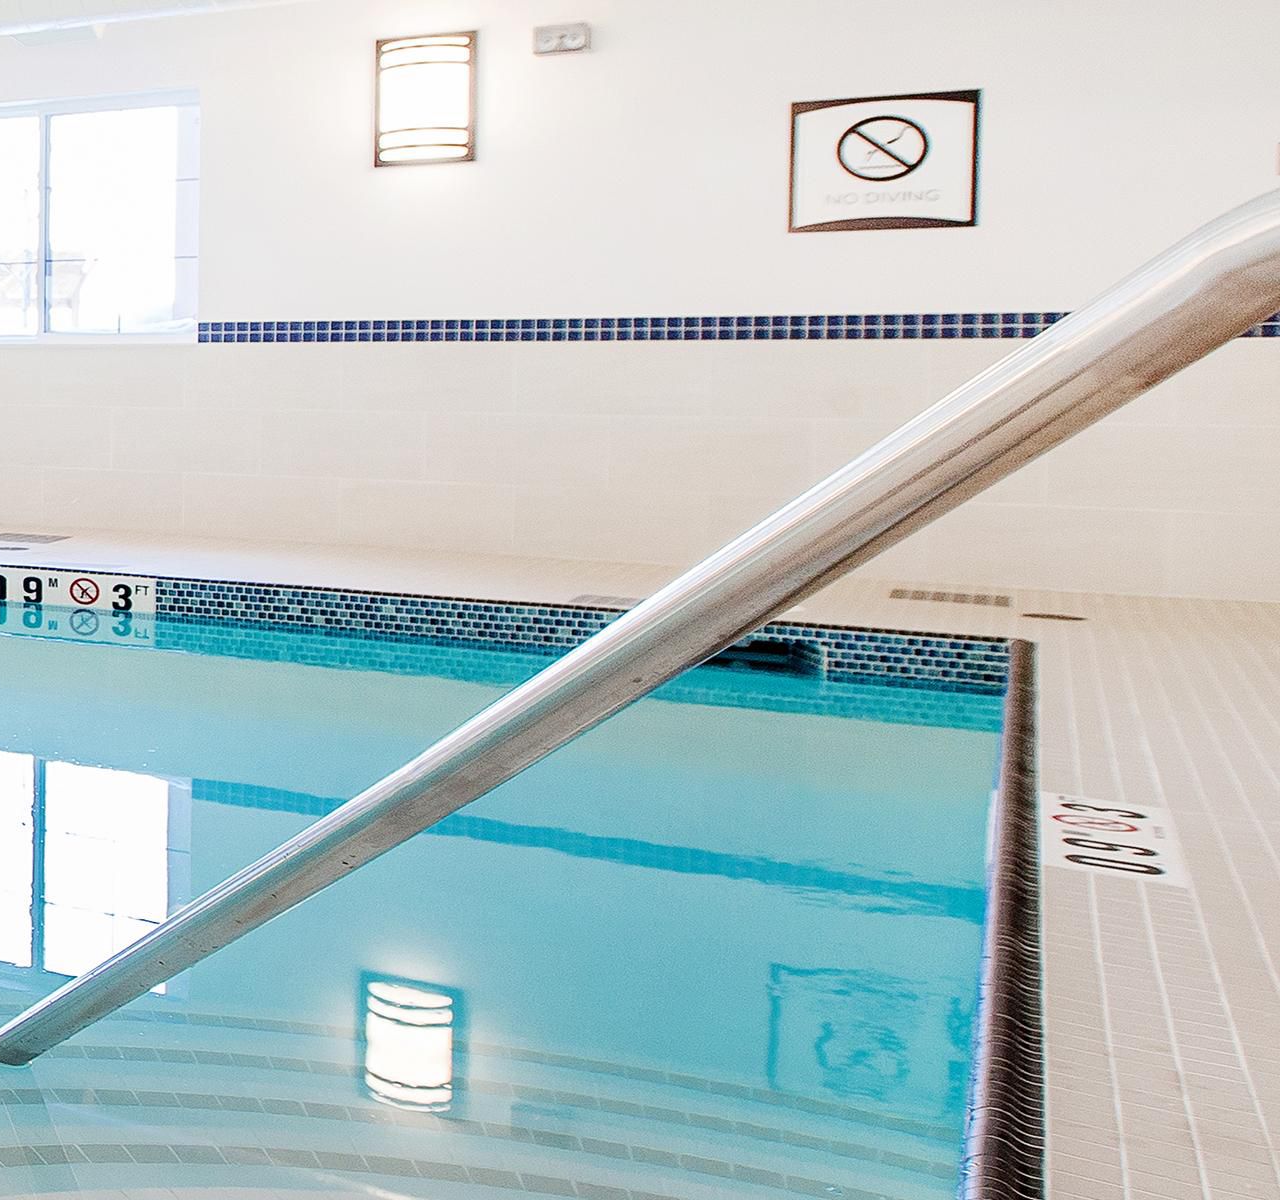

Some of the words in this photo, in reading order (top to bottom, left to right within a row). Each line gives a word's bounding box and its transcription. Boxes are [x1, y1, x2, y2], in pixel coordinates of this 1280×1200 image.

[825, 192, 858, 205] NO
[865, 188, 943, 204] DIVING
[48, 578, 59, 588] M
[112, 584, 132, 611] 3
[135, 585, 149, 596] FT
